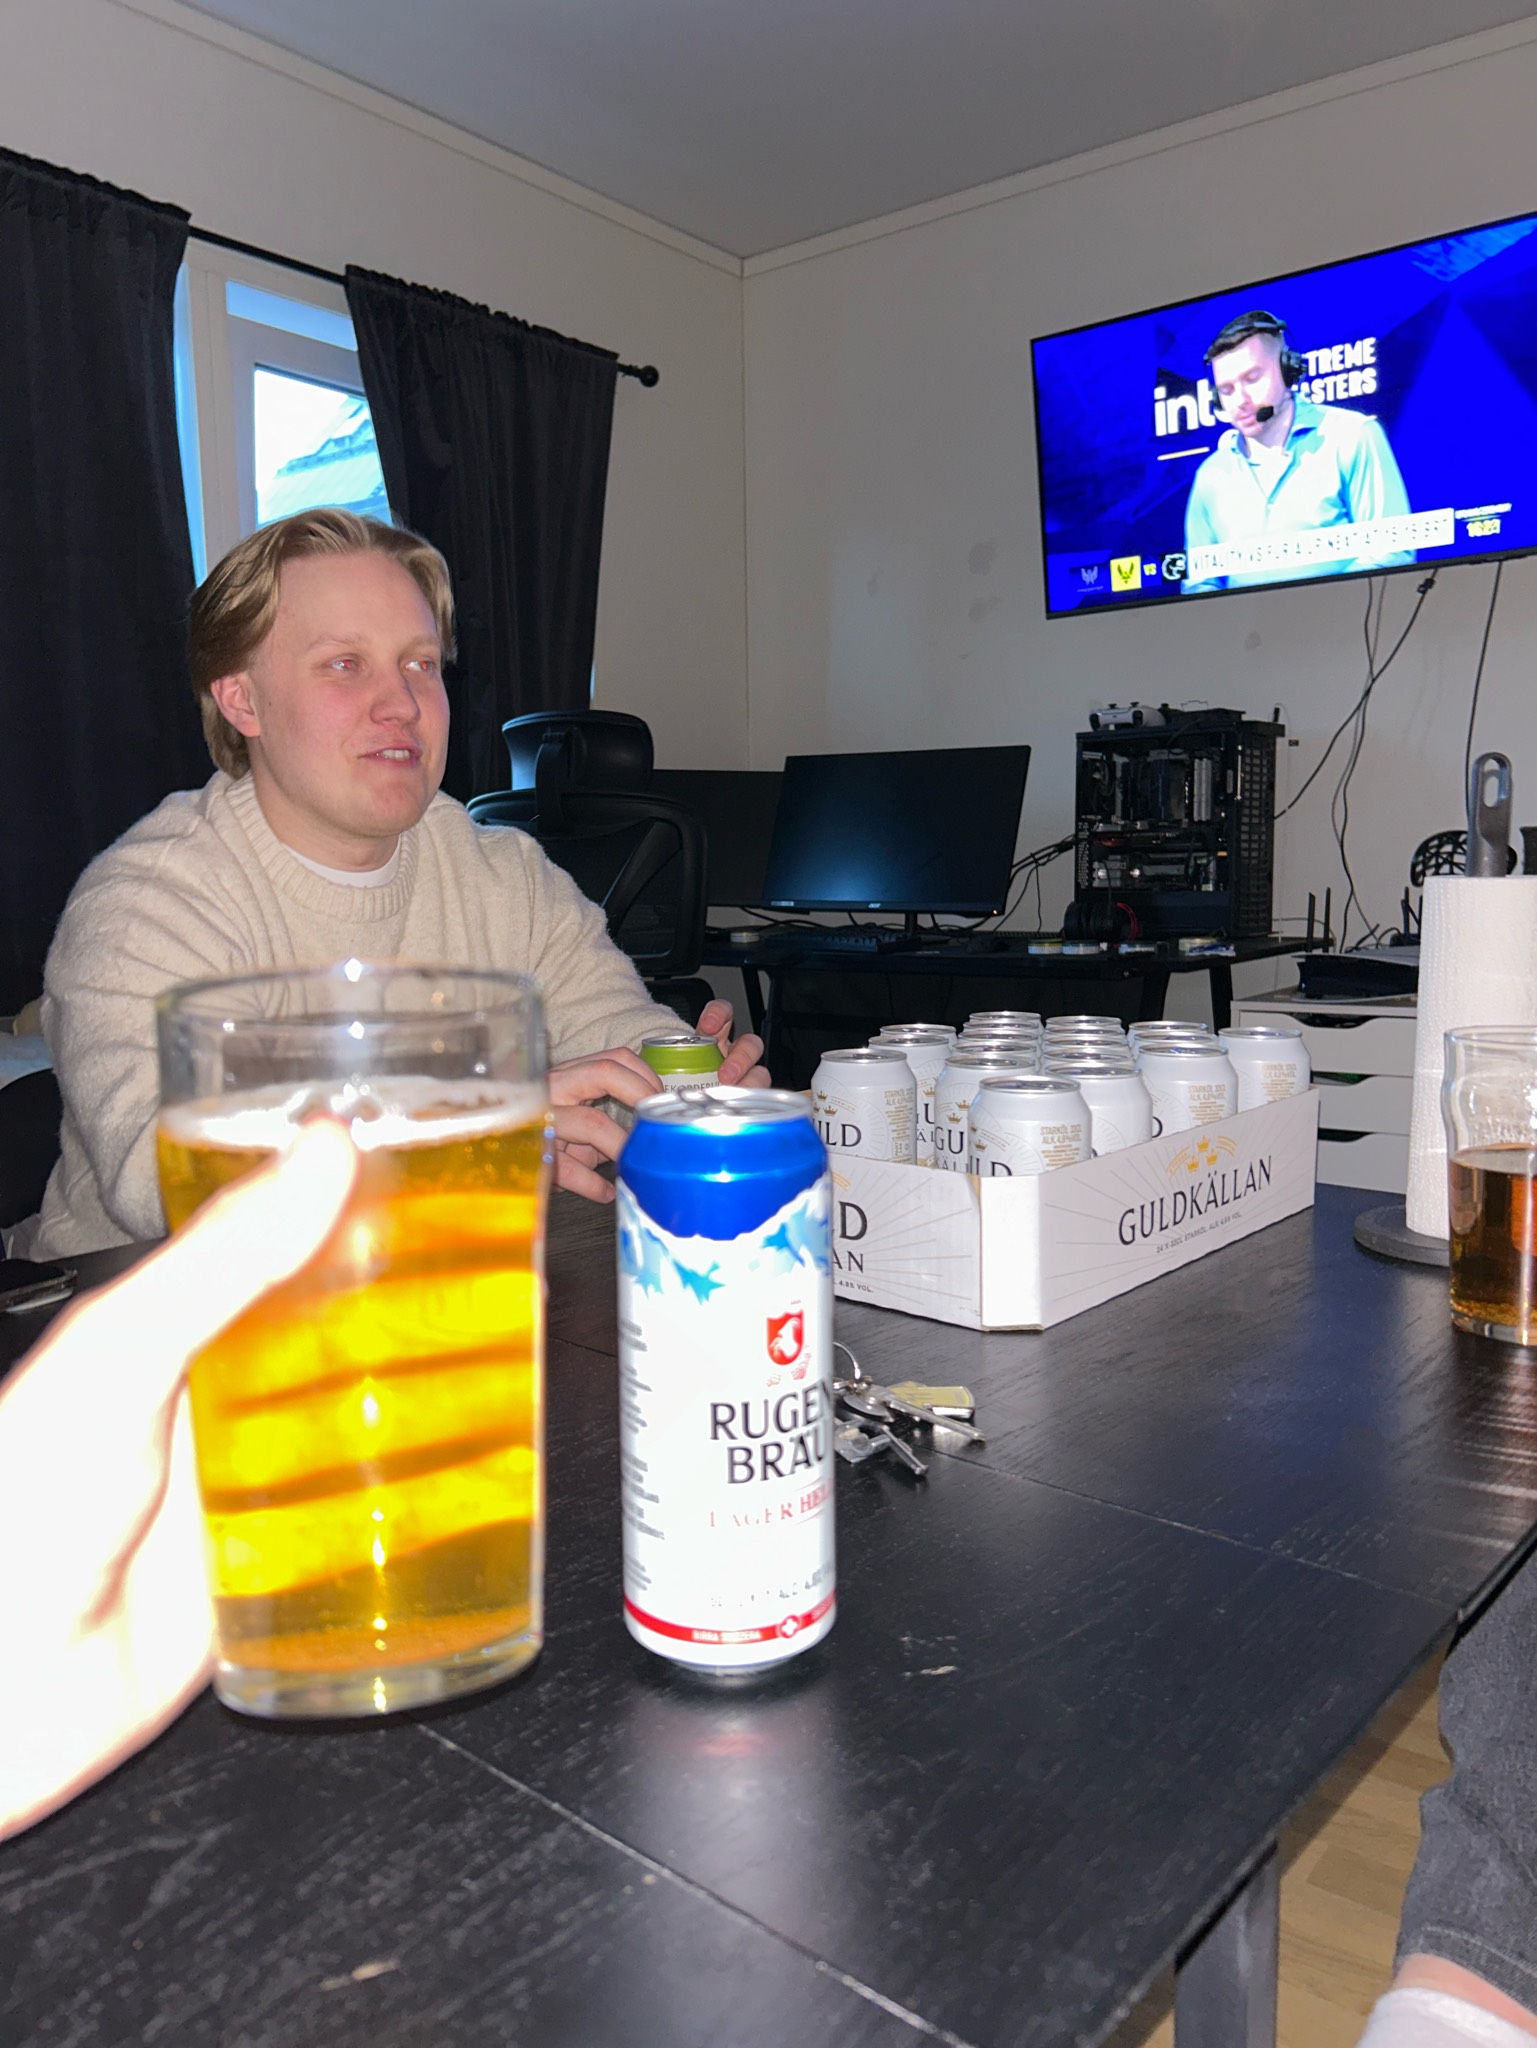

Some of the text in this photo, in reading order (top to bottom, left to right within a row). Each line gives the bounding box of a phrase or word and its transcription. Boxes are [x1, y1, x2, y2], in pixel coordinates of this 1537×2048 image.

[1301, 337, 1377, 376] TREME
[1292, 368, 1378, 404] ASTERS
[812, 1118, 862, 1147] ULD
[1118, 1155, 1273, 1245] GULDKÄLLAN
